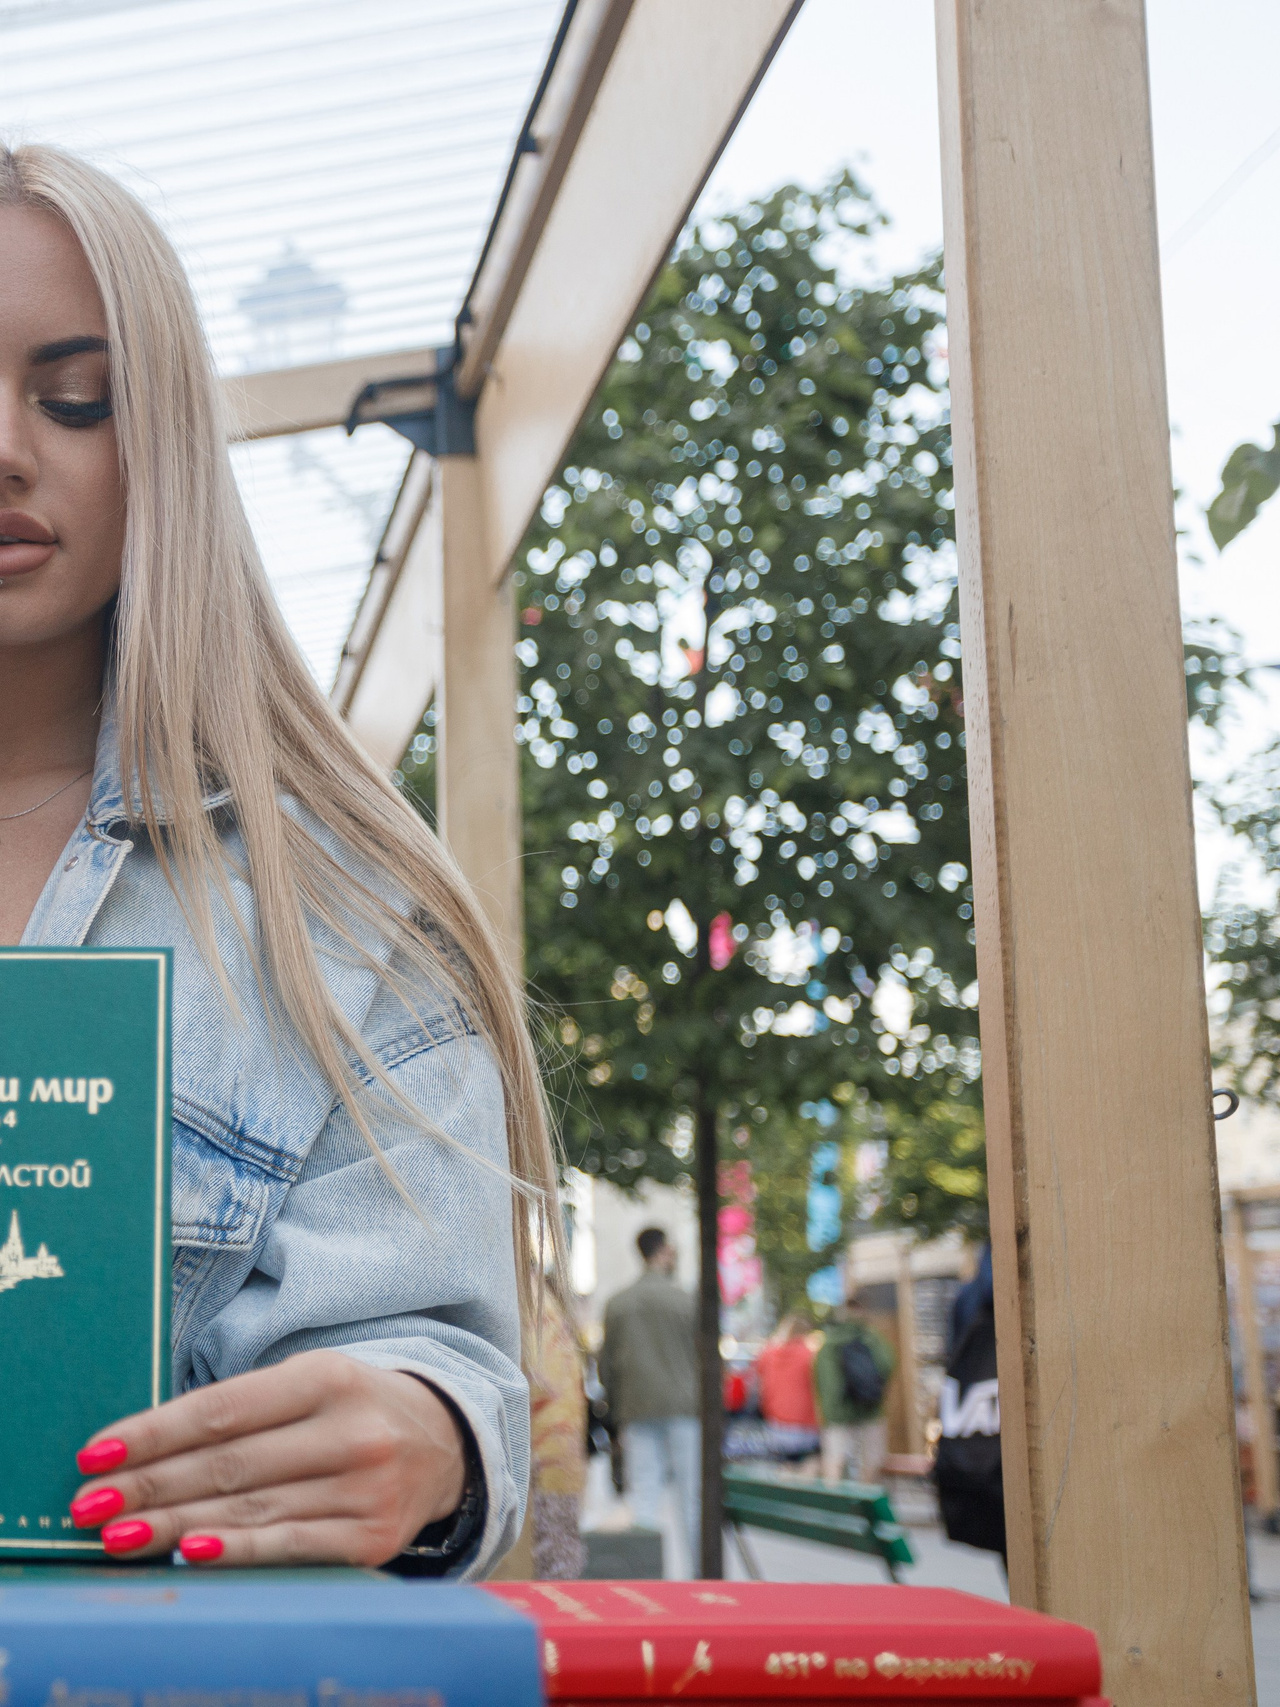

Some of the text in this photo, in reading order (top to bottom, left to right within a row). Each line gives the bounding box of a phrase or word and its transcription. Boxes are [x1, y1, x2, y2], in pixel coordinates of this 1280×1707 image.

[30, 1077, 114, 1115] мир
[3, 1109, 17, 1128] 4
[834, 1658, 869, 1680] по
